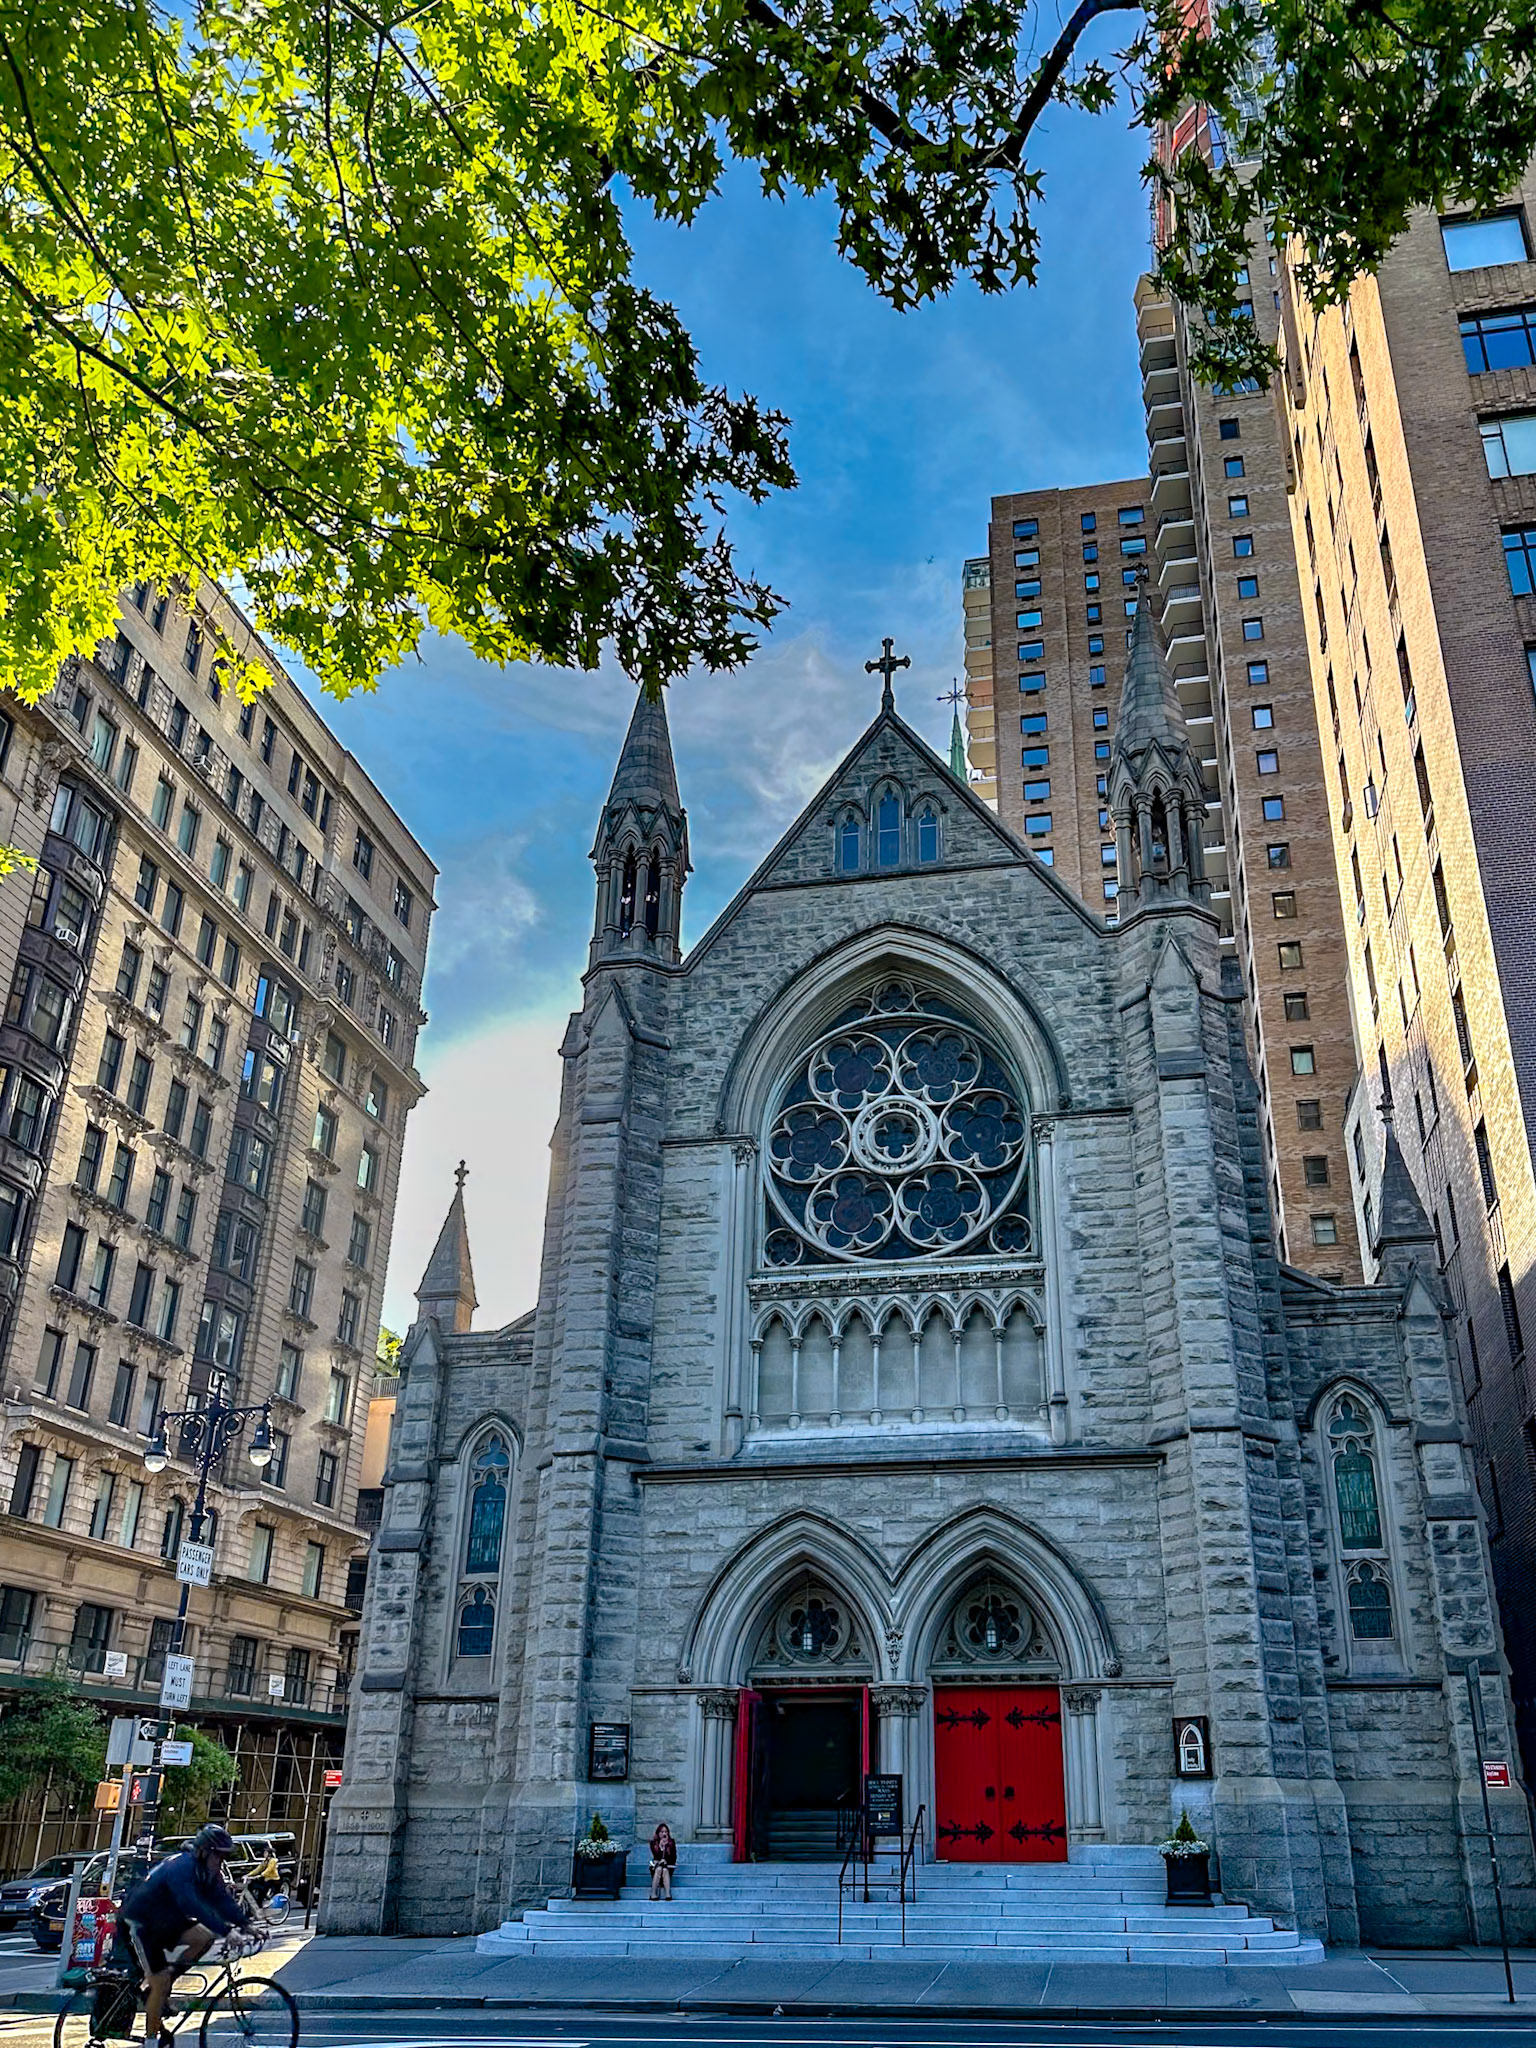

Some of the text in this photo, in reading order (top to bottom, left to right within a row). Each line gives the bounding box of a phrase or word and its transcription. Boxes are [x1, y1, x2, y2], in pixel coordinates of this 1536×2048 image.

[182, 1546, 211, 1564] PASSENGER
[180, 1562, 209, 1579] CARS ONLY
[168, 1661, 192, 1673] LEFT LANE
[170, 1675, 186, 1688] MUST
[164, 1691, 188, 1703] TURN LEFT
